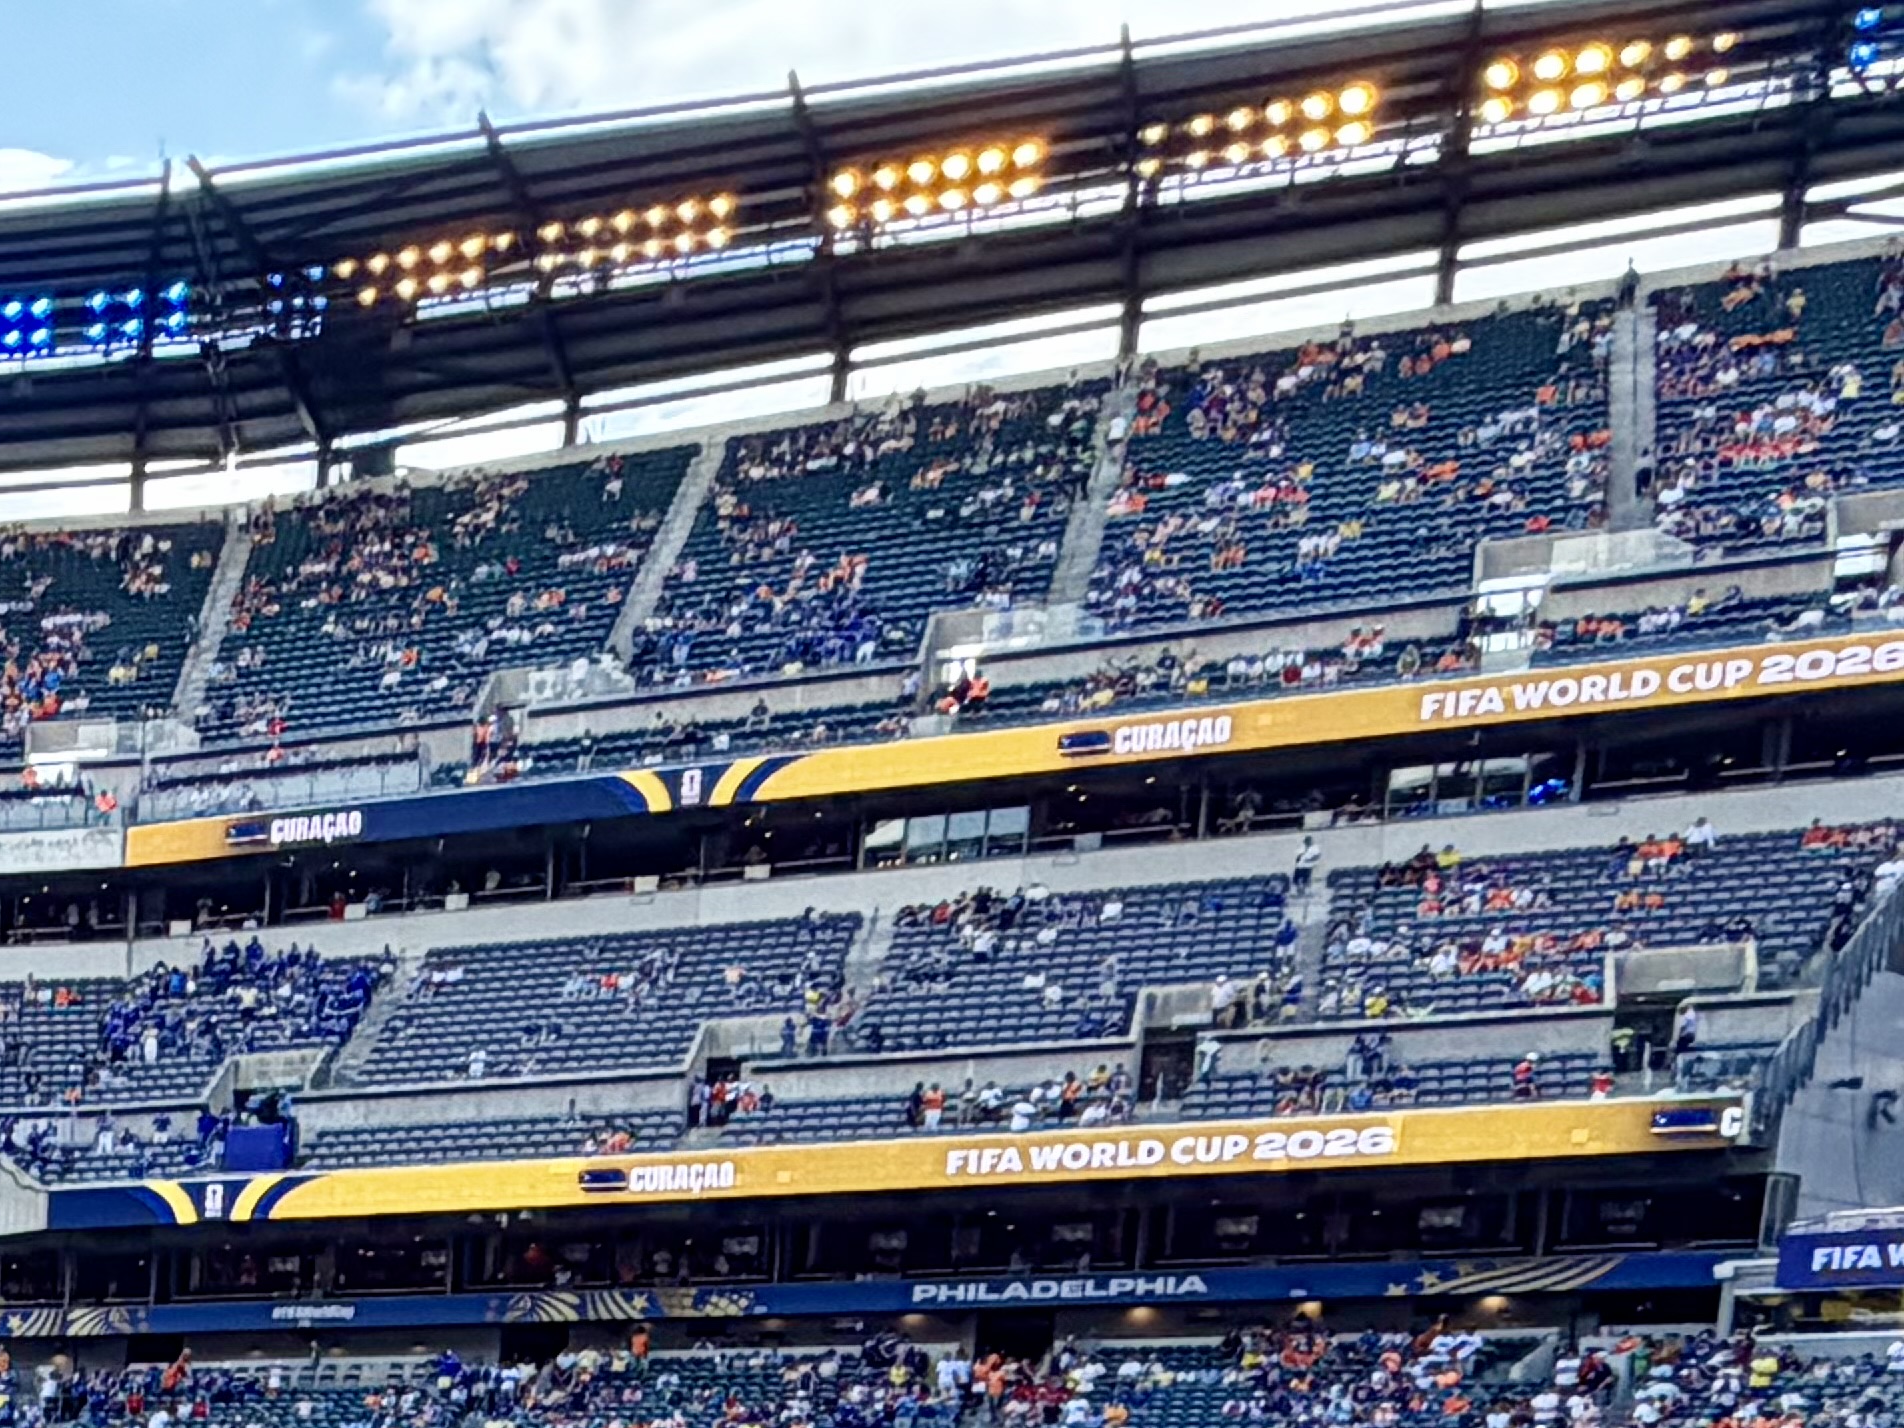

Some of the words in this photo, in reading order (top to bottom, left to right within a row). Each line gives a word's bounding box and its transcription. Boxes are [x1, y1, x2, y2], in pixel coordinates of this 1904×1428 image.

[1420, 687, 1505, 720] FIFA
[1508, 670, 1660, 710] WORLD
[1667, 659, 1752, 697] CUP
[1757, 641, 1904, 684] 2026
[1114, 716, 1231, 754] CURAÇAO
[271, 811, 362, 844] CURAÇAO
[946, 1146, 1024, 1175] FIFA
[1029, 1140, 1166, 1170] WORLD
[1171, 1134, 1249, 1164] CUP
[1252, 1130, 1400, 1160] 2026
[629, 1161, 734, 1194] CURAÇAO
[1812, 1245, 1882, 1271] FIFA
[912, 1275, 1208, 1303] PHILADELPHIA
